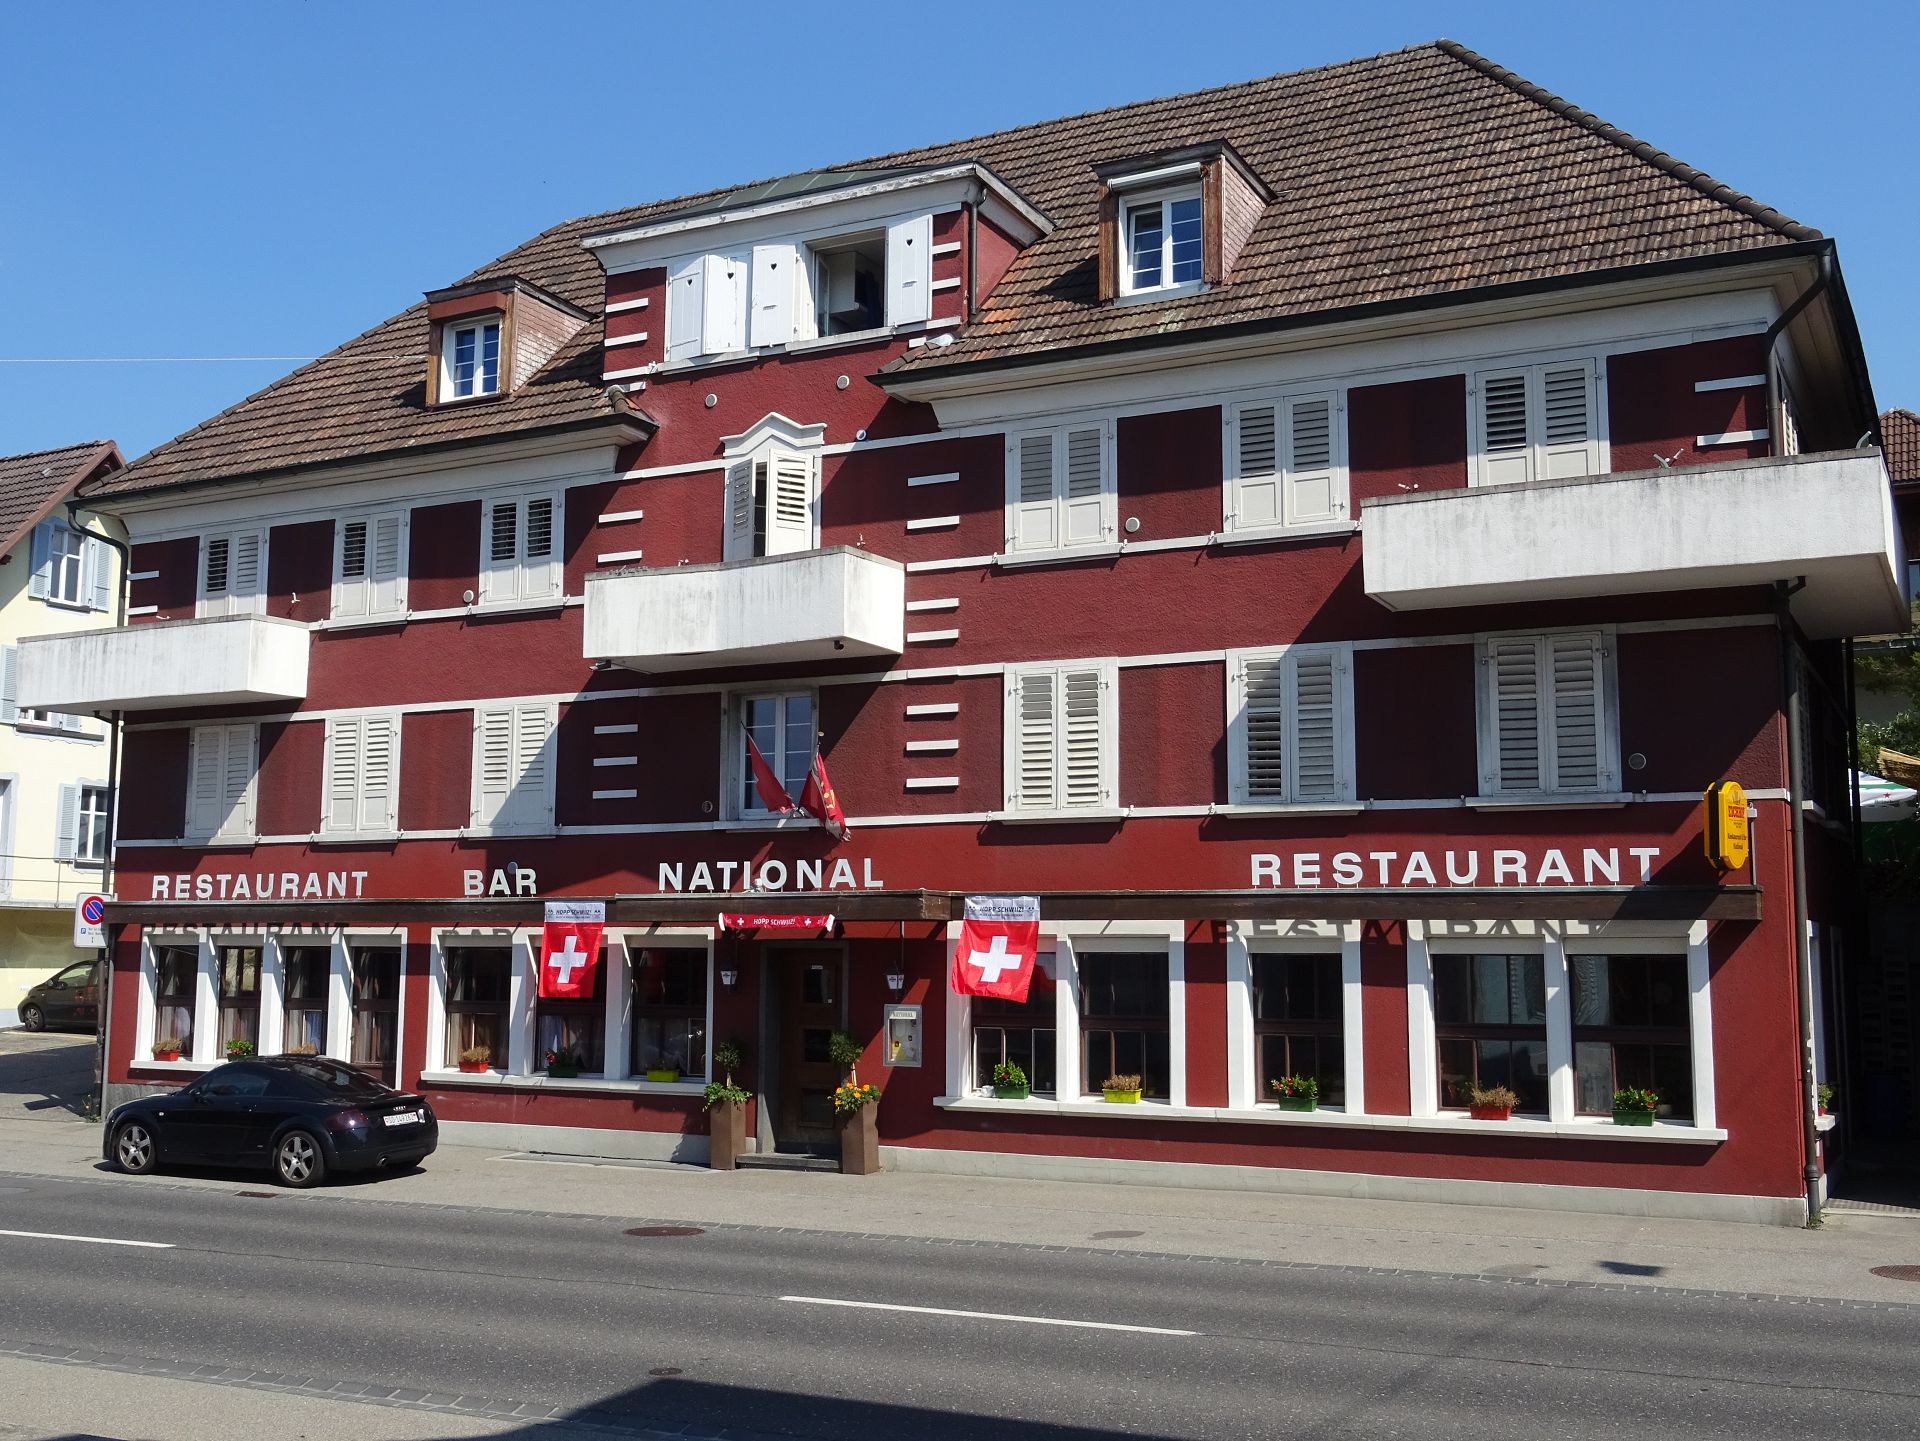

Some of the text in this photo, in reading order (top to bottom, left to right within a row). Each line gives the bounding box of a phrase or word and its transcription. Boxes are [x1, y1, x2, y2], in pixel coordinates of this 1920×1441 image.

[463, 868, 537, 896] BAR
[658, 858, 884, 890] NATIONAL
[1250, 848, 1661, 886] RESTAURANT
[152, 871, 368, 898] RESTAURANT
